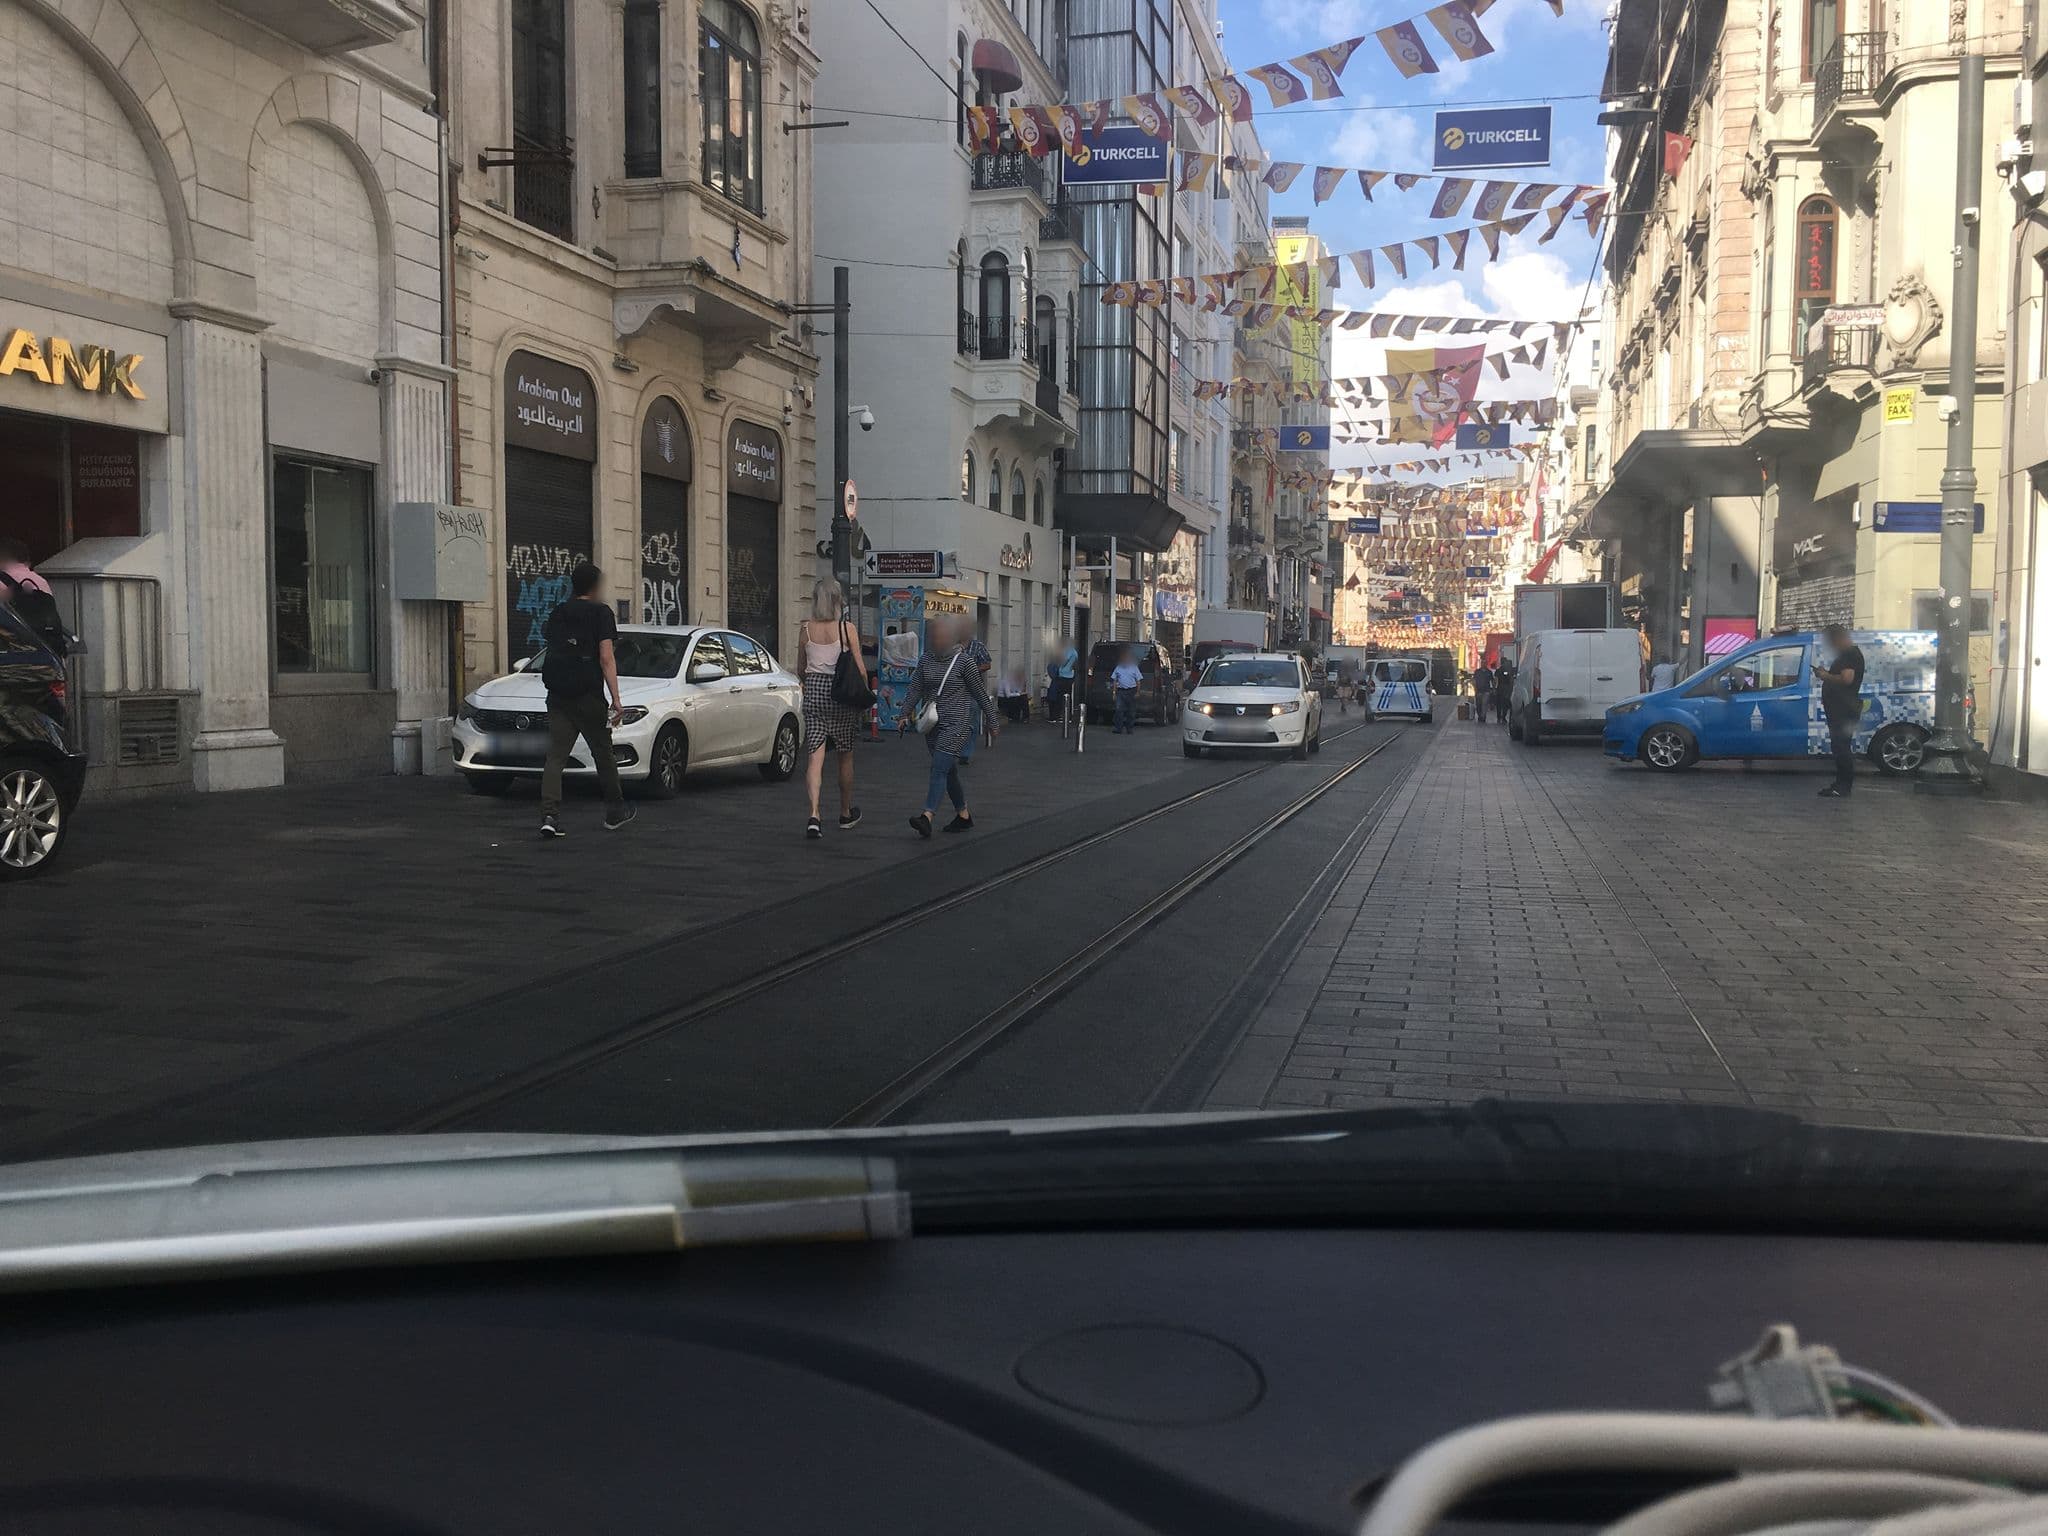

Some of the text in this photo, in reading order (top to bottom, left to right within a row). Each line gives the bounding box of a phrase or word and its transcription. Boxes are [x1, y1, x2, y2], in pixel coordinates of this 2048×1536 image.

[1467, 129, 1541, 145] TURKCELL
[1092, 146, 1160, 161] TURKCELL
[518, 375, 582, 408] Arabian Oud
[518, 404, 583, 436] العربية للعود
[1887, 405, 1907, 415] FAX
[735, 438, 775, 461] Arabian Oud
[1793, 534, 1825, 560] MAC
